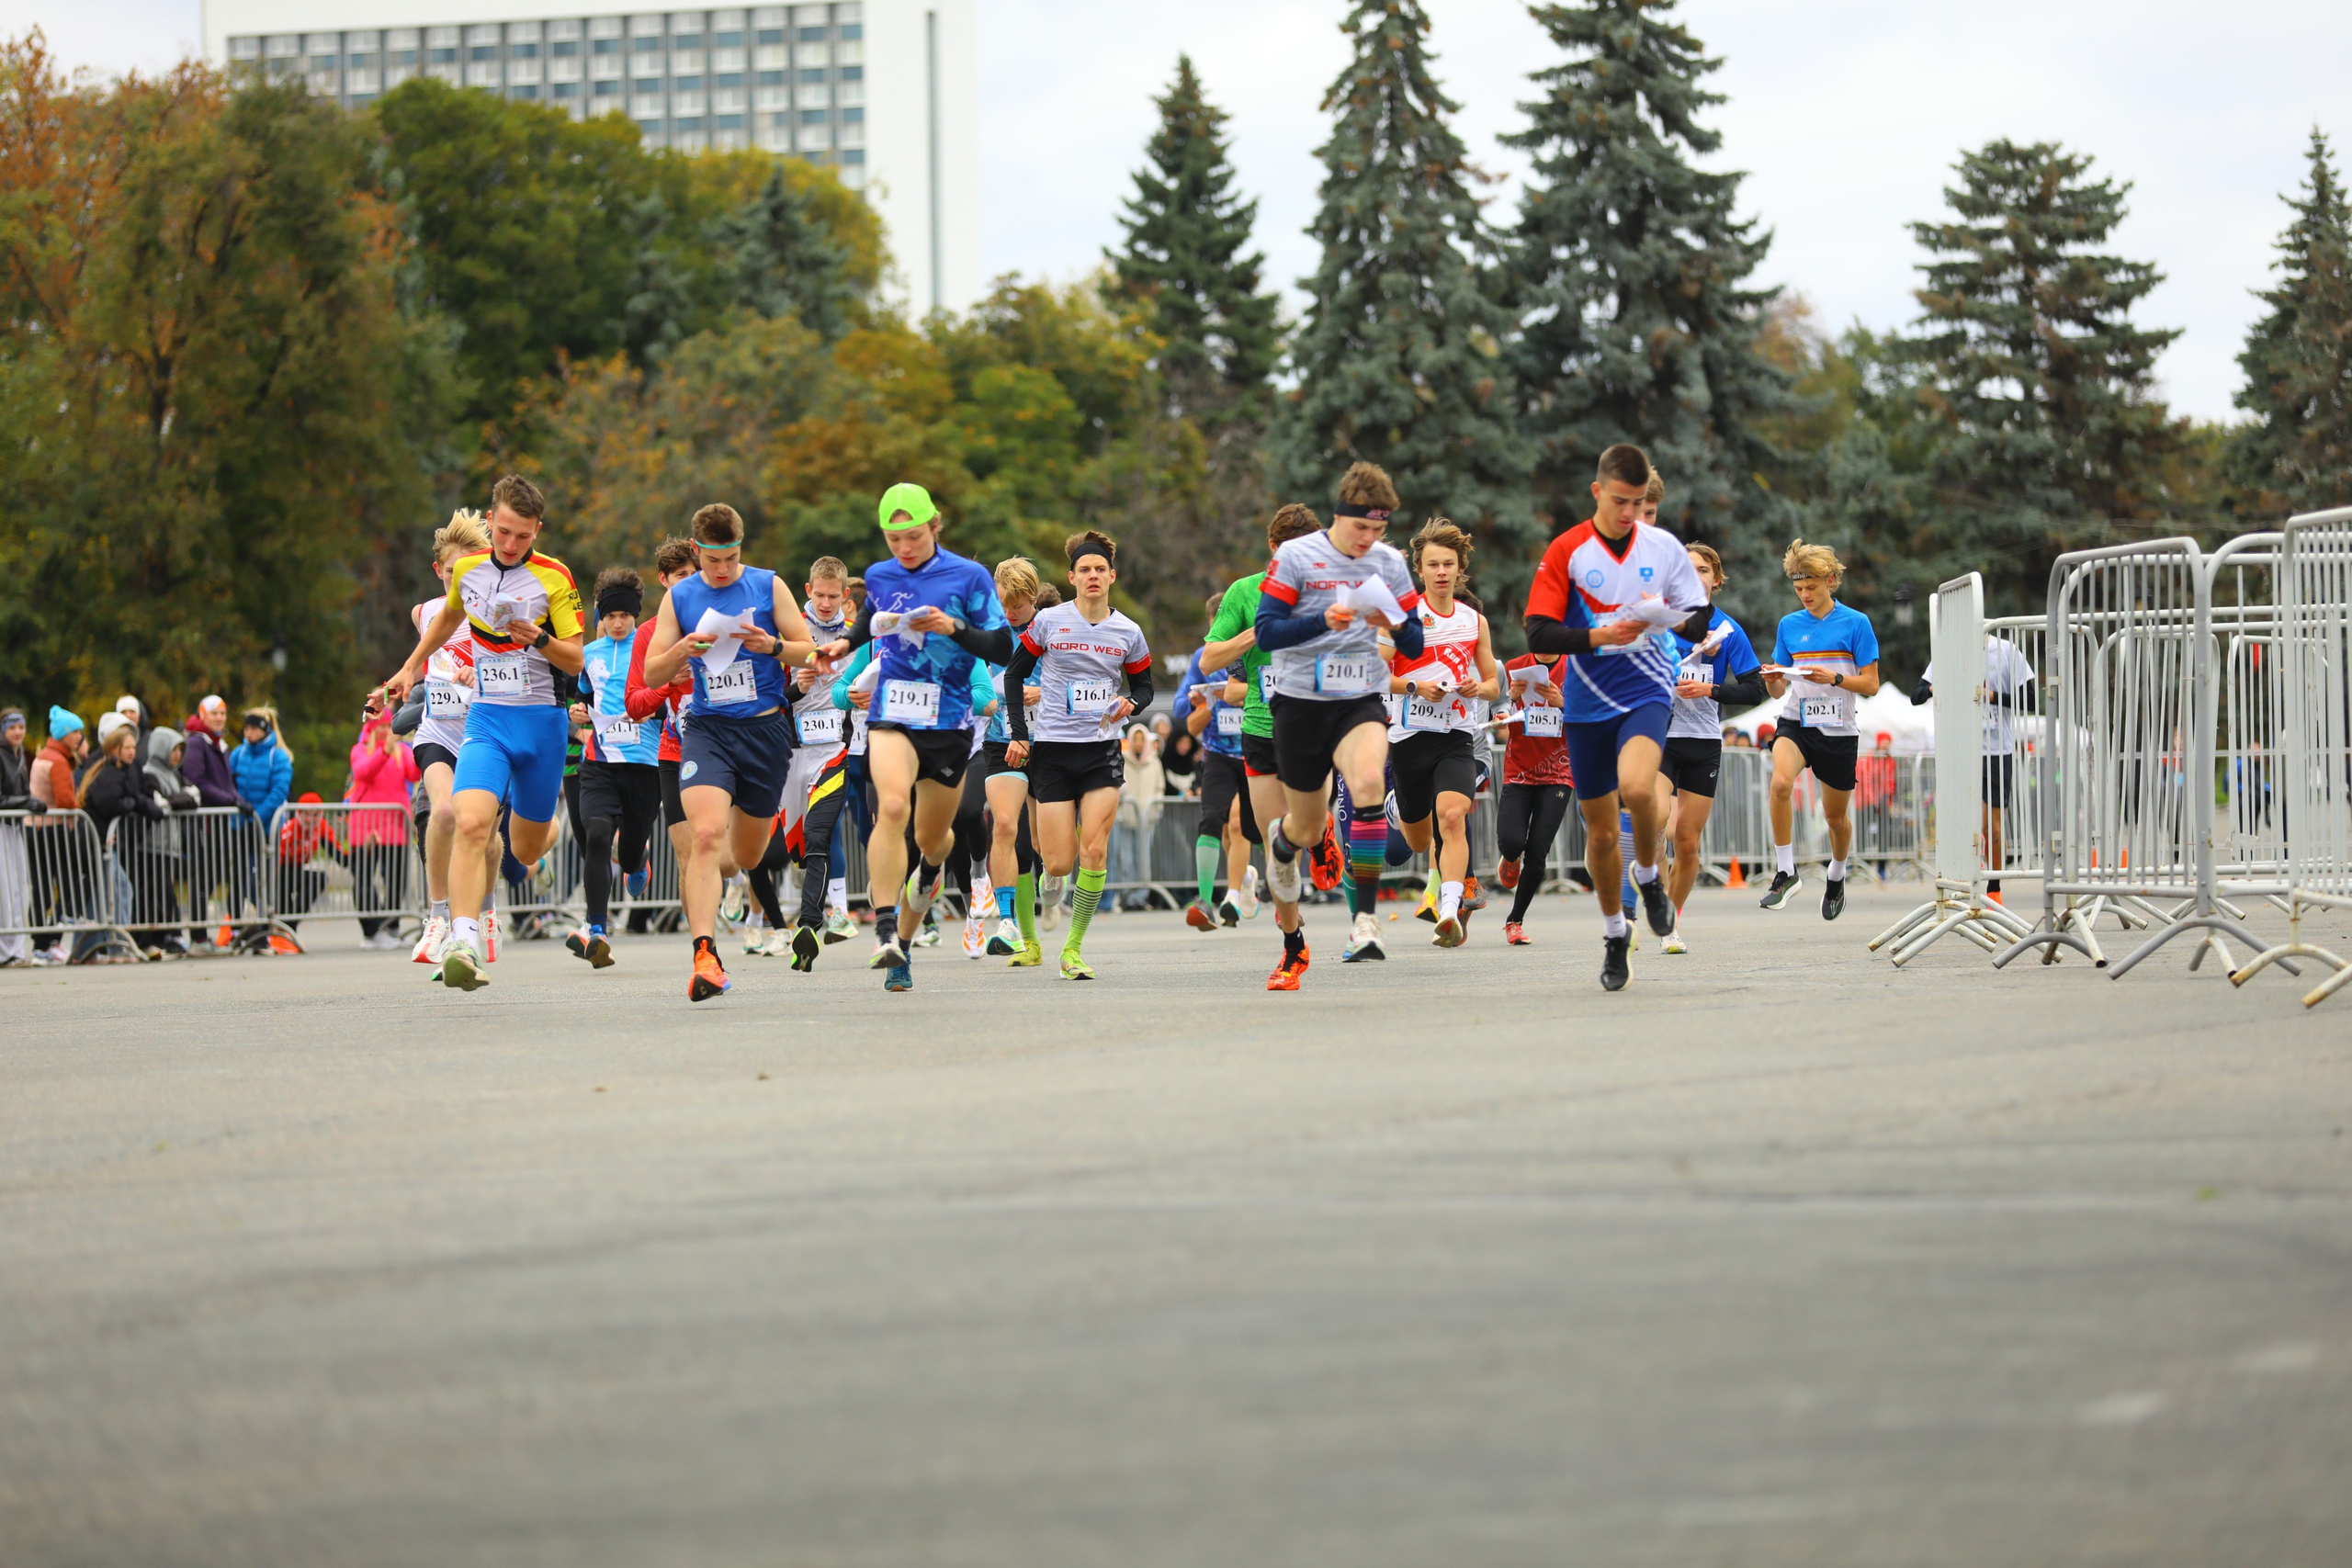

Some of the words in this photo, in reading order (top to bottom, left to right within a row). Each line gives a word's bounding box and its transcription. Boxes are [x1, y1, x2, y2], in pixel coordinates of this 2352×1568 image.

[1050, 642, 1089, 651] NORD
[1093, 646, 1127, 657] WEST
[1443, 647, 1461, 664] Run
[448, 649, 465, 668] Run
[481, 667, 519, 682] 236.1
[1326, 664, 1364, 679] 210.1
[707, 672, 745, 690] 220.1
[431, 692, 461, 705] 229.1
[889, 689, 929, 706] 219.1
[1075, 689, 1107, 701] 216.1
[1409, 704, 1443, 719] 209.1
[1806, 705, 1837, 716] 202.1
[605, 722, 632, 733] 31.1
[804, 718, 835, 732] 230.1
[1529, 715, 1557, 726] 205.1
